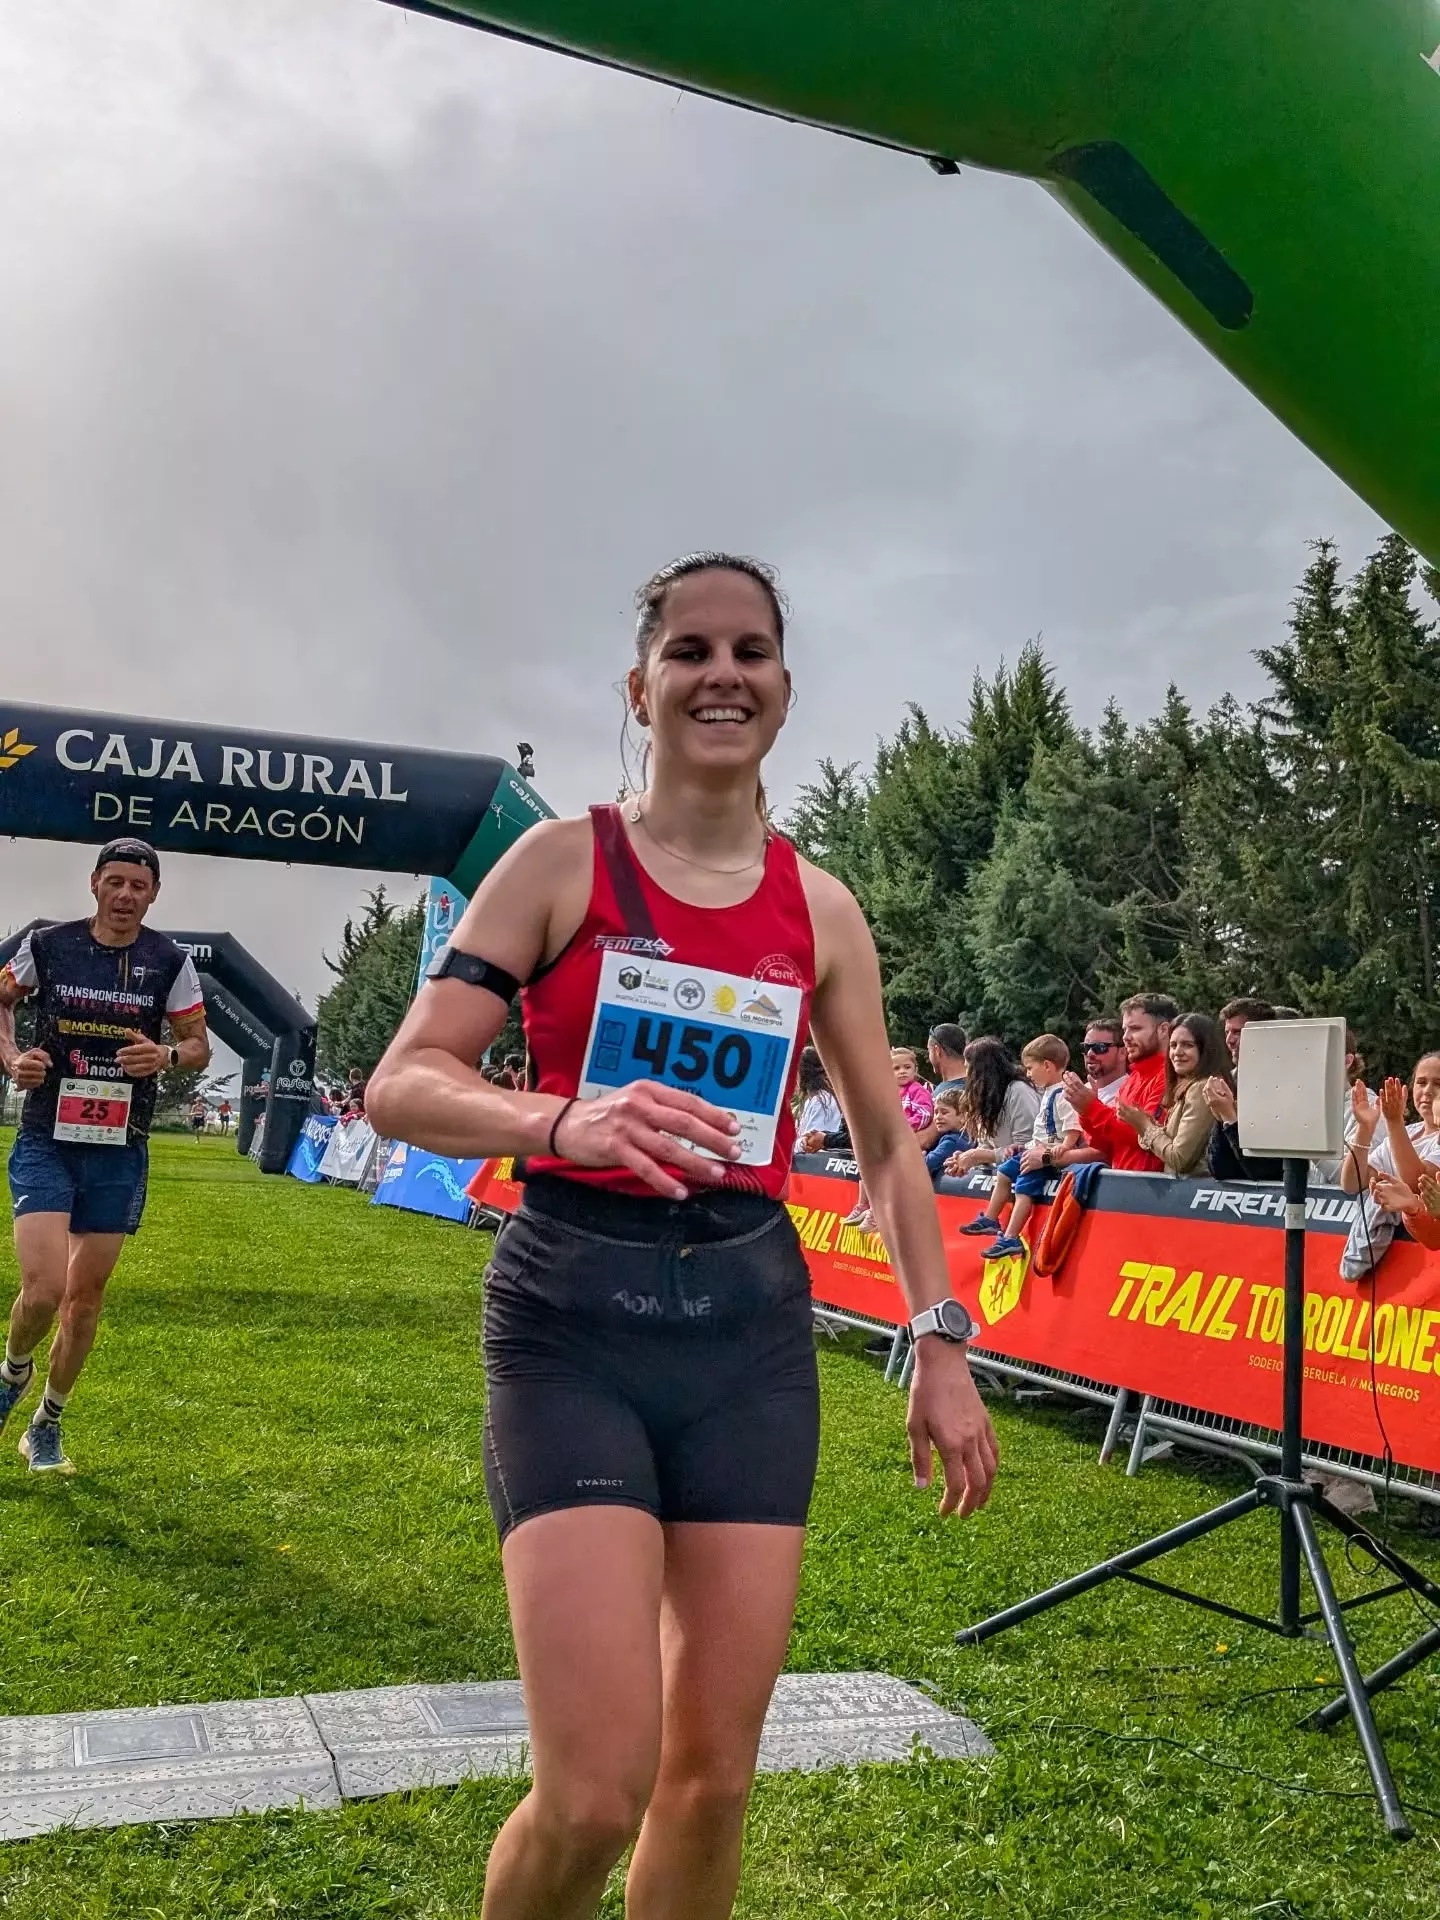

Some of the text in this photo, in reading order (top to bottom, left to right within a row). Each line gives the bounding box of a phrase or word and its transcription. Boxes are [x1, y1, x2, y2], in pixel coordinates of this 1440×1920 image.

[55, 728, 409, 803] CAJA RURAL
[93, 791, 365, 845] DE ARAGÓN
[510, 780, 548, 820] cajaru
[56, 984, 154, 1007] TRANSMONEGRINOS
[769, 968, 795, 982] GENTE
[212, 994, 226, 1010] Pisa
[252, 1032, 271, 1050] mejor
[632, 1017, 753, 1090] 450
[80, 1099, 110, 1121] 25
[1190, 1188, 1357, 1223] FIREHW
[1108, 1260, 1440, 1375] TRAIL TOROLLONE
[1249, 1354, 1285, 1372] SODETO
[1303, 1365, 1347, 1387] BERUELA
[1359, 1380, 1421, 1402] MONEGROS
[577, 1478, 624, 1487] EVADICT
